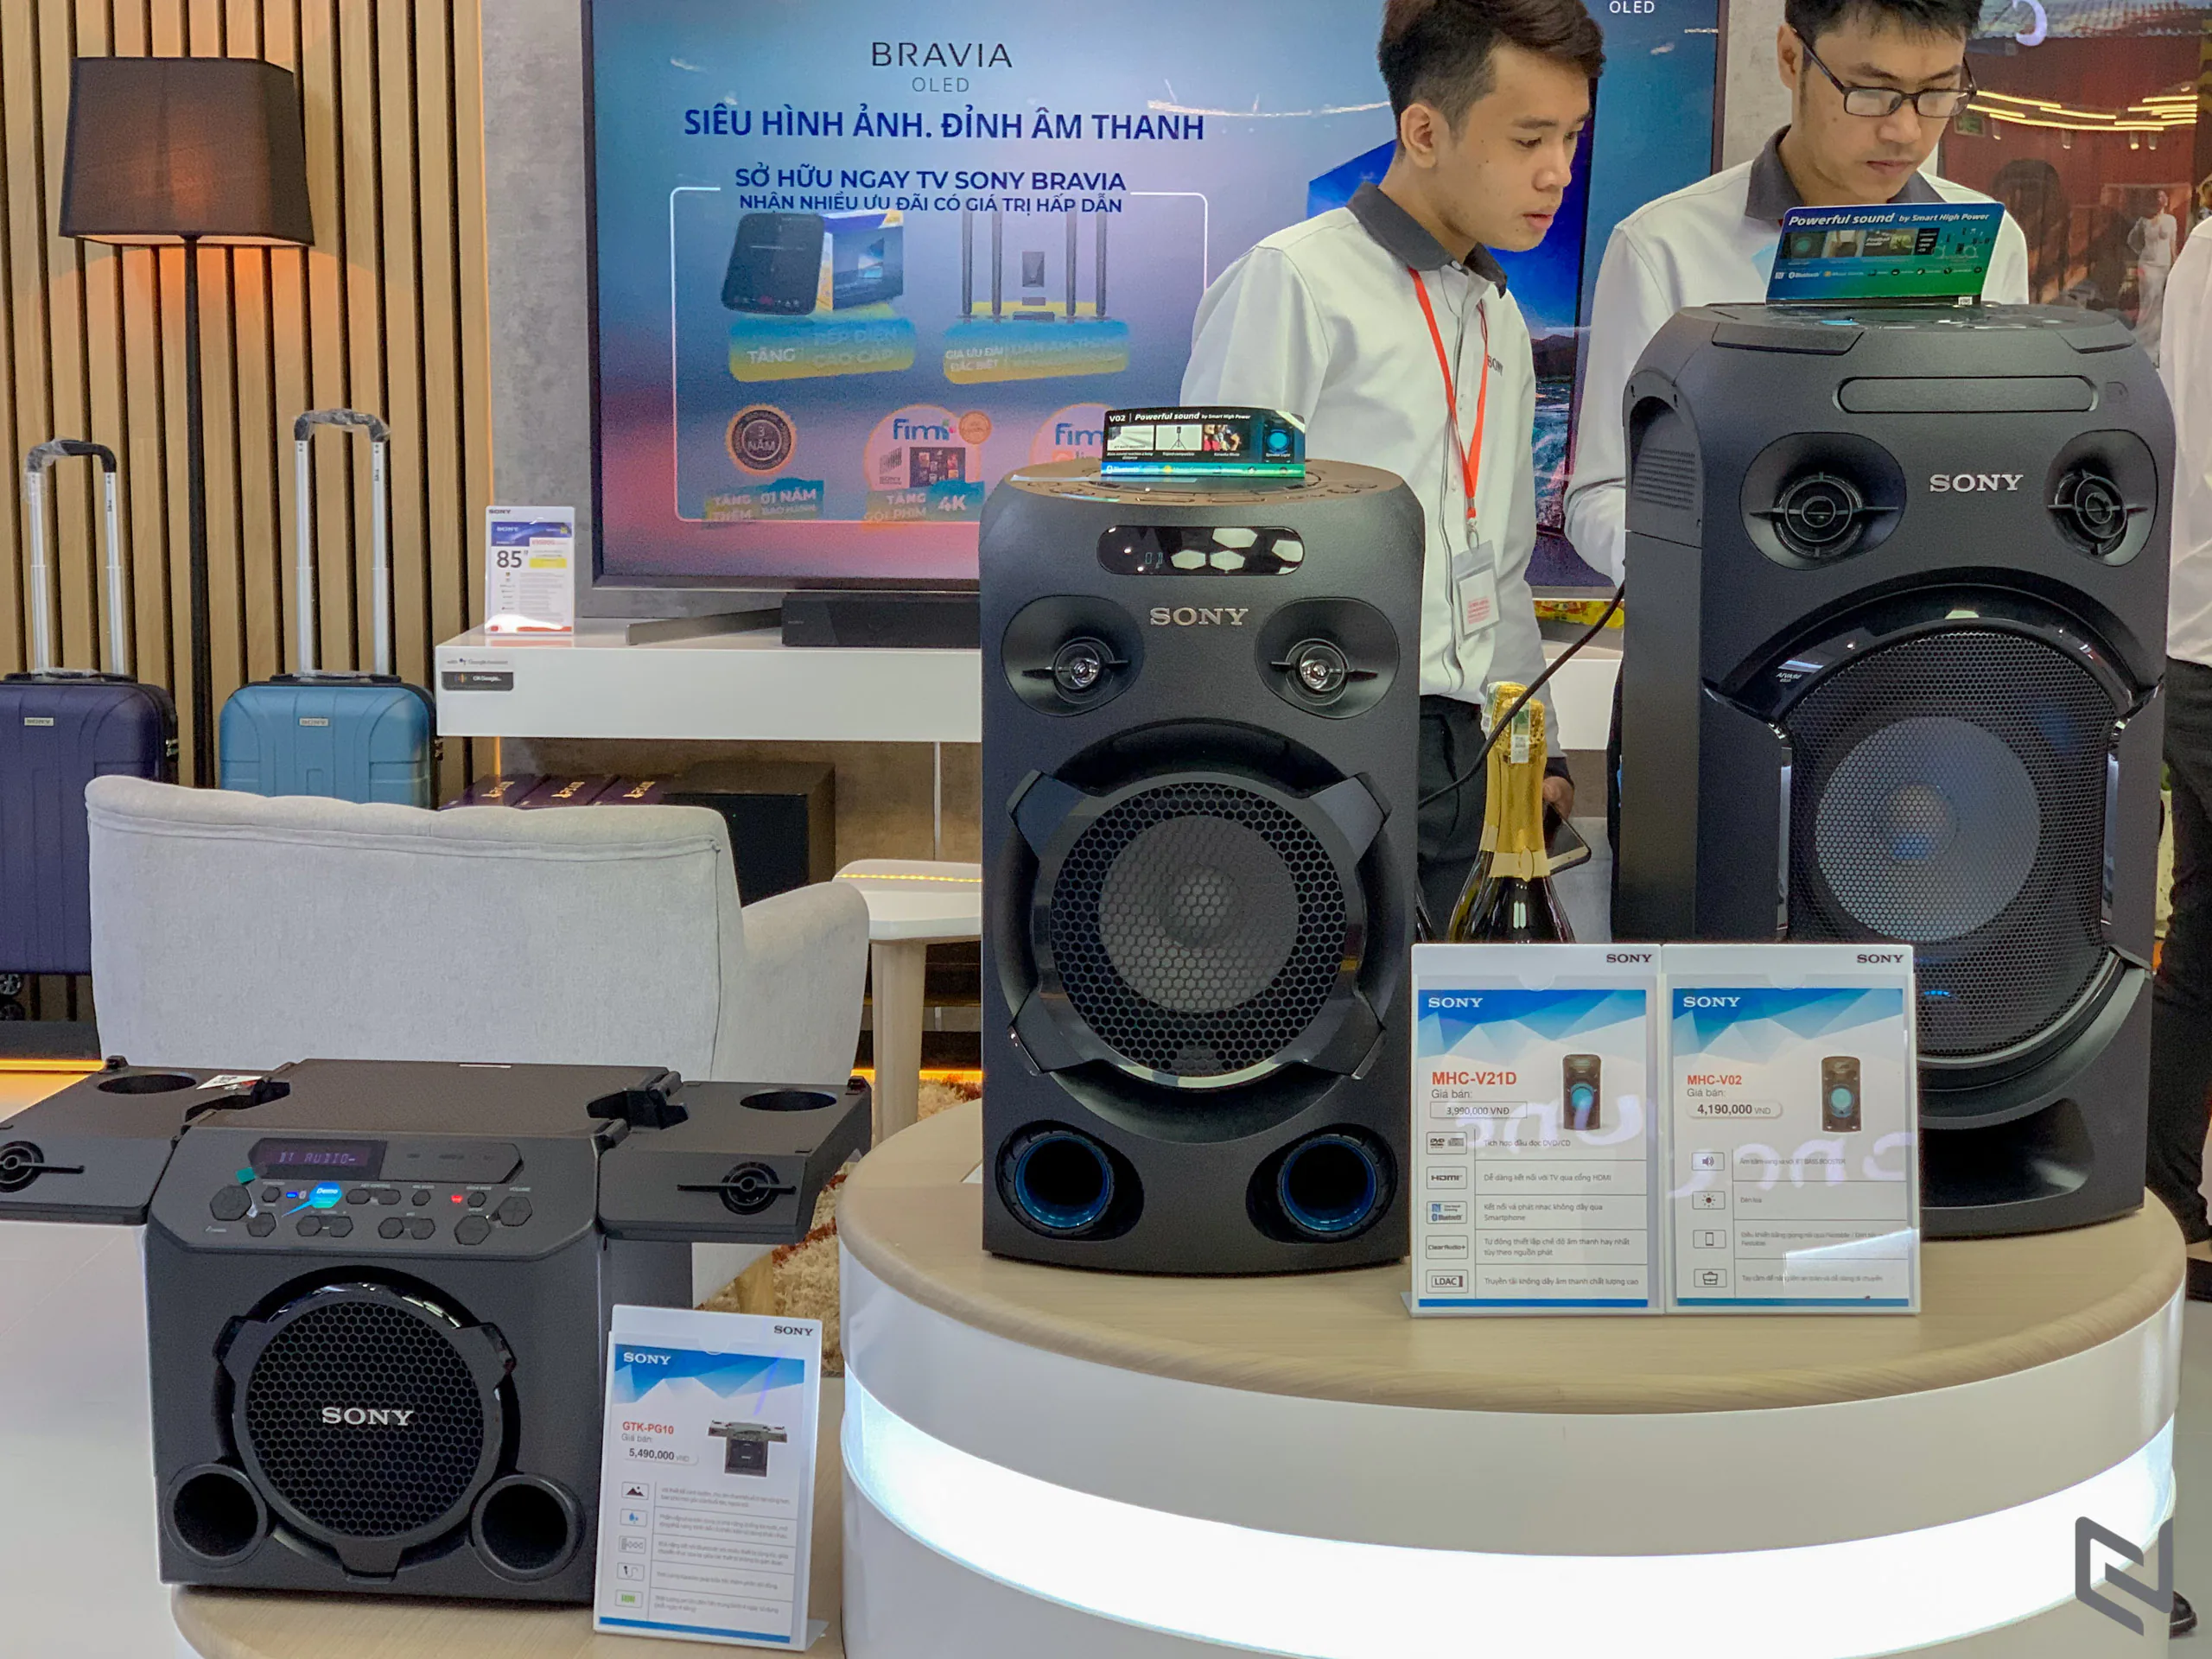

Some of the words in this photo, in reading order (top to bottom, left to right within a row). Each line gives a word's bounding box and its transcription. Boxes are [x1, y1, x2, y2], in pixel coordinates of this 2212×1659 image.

[1610, 1, 1655, 13] OLED
[872, 42, 1013, 68] BRAVIA
[912, 77, 969, 92] OLED
[684, 103, 751, 136] SIÊU
[761, 105, 843, 137] HÌNH
[852, 103, 931, 139] ẢNH.
[940, 105, 1021, 139] ĐỈNH
[1033, 105, 1082, 140] ÂM
[1092, 113, 1205, 140] THANH
[735, 162, 770, 188] SỞ
[778, 163, 833, 188] HỮU
[840, 169, 911, 189] NGAY
[917, 171, 949, 189] TV
[955, 171, 1025, 191] SONY
[1032, 172, 1127, 191] BRAVIA
[740, 190, 794, 214] NHẬN
[799, 189, 857, 212] NHIỀU
[863, 194, 890, 212] ƯU
[896, 191, 928, 212] ĐÃI
[933, 191, 960, 212] CÓ
[966, 192, 997, 212] GIÁ
[1001, 195, 1030, 217] TRỊ
[1037, 191, 1075, 213] HẤP
[1082, 192, 1122, 213] DẪN
[1789, 214, 1849, 226] Powerful
[1853, 213, 1895, 224] sound
[1929, 474, 2024, 493] SONY
[938, 494, 966, 512] 4K
[1150, 607, 1249, 626] SONY
[1606, 953, 1653, 964] SONY
[1857, 954, 1904, 964] SONY
[1427, 997, 1484, 1009] SONY
[1683, 996, 1740, 1008] SONY
[1432, 1071, 1516, 1085] MHC-V21D
[1688, 1075, 1742, 1085] MHC-V02
[1432, 1089, 1448, 1098] Giá
[1452, 1090, 1472, 1098] bán:
[1446, 1107, 1488, 1116] 3,990,000
[1697, 1104, 1752, 1116] 4,190,000
[773, 1325, 814, 1337] SONY
[623, 1352, 671, 1365] SONY
[321, 1407, 414, 1427] SONY
[622, 1421, 674, 1434] GTK-PG10
[629, 1448, 674, 1459] 5,490,000
